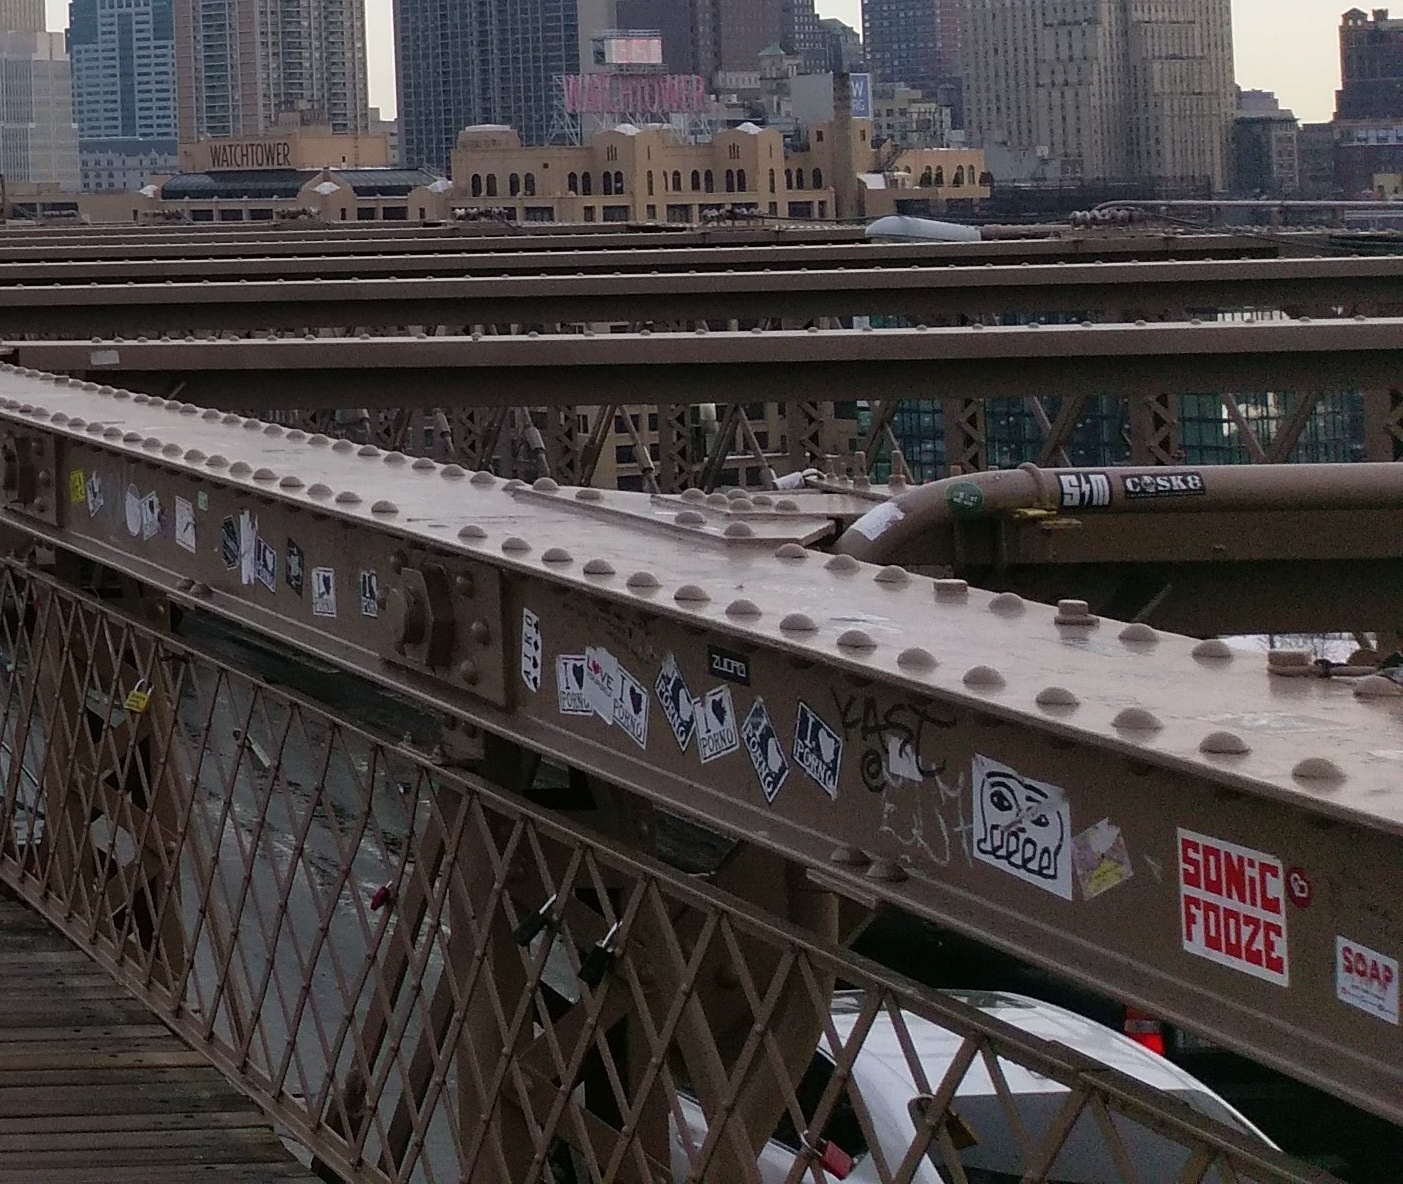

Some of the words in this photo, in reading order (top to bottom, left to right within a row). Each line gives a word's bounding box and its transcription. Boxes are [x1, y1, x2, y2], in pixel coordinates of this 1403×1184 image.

[563, 74, 707, 113] WATCHTOWER
[851, 81, 864, 97] W
[210, 142, 291, 168] WATCHTOWER
[700, 728, 733, 755] PORNO
[1183, 894, 1284, 974] FOOZE
[1342, 946, 1393, 989] SOAP
